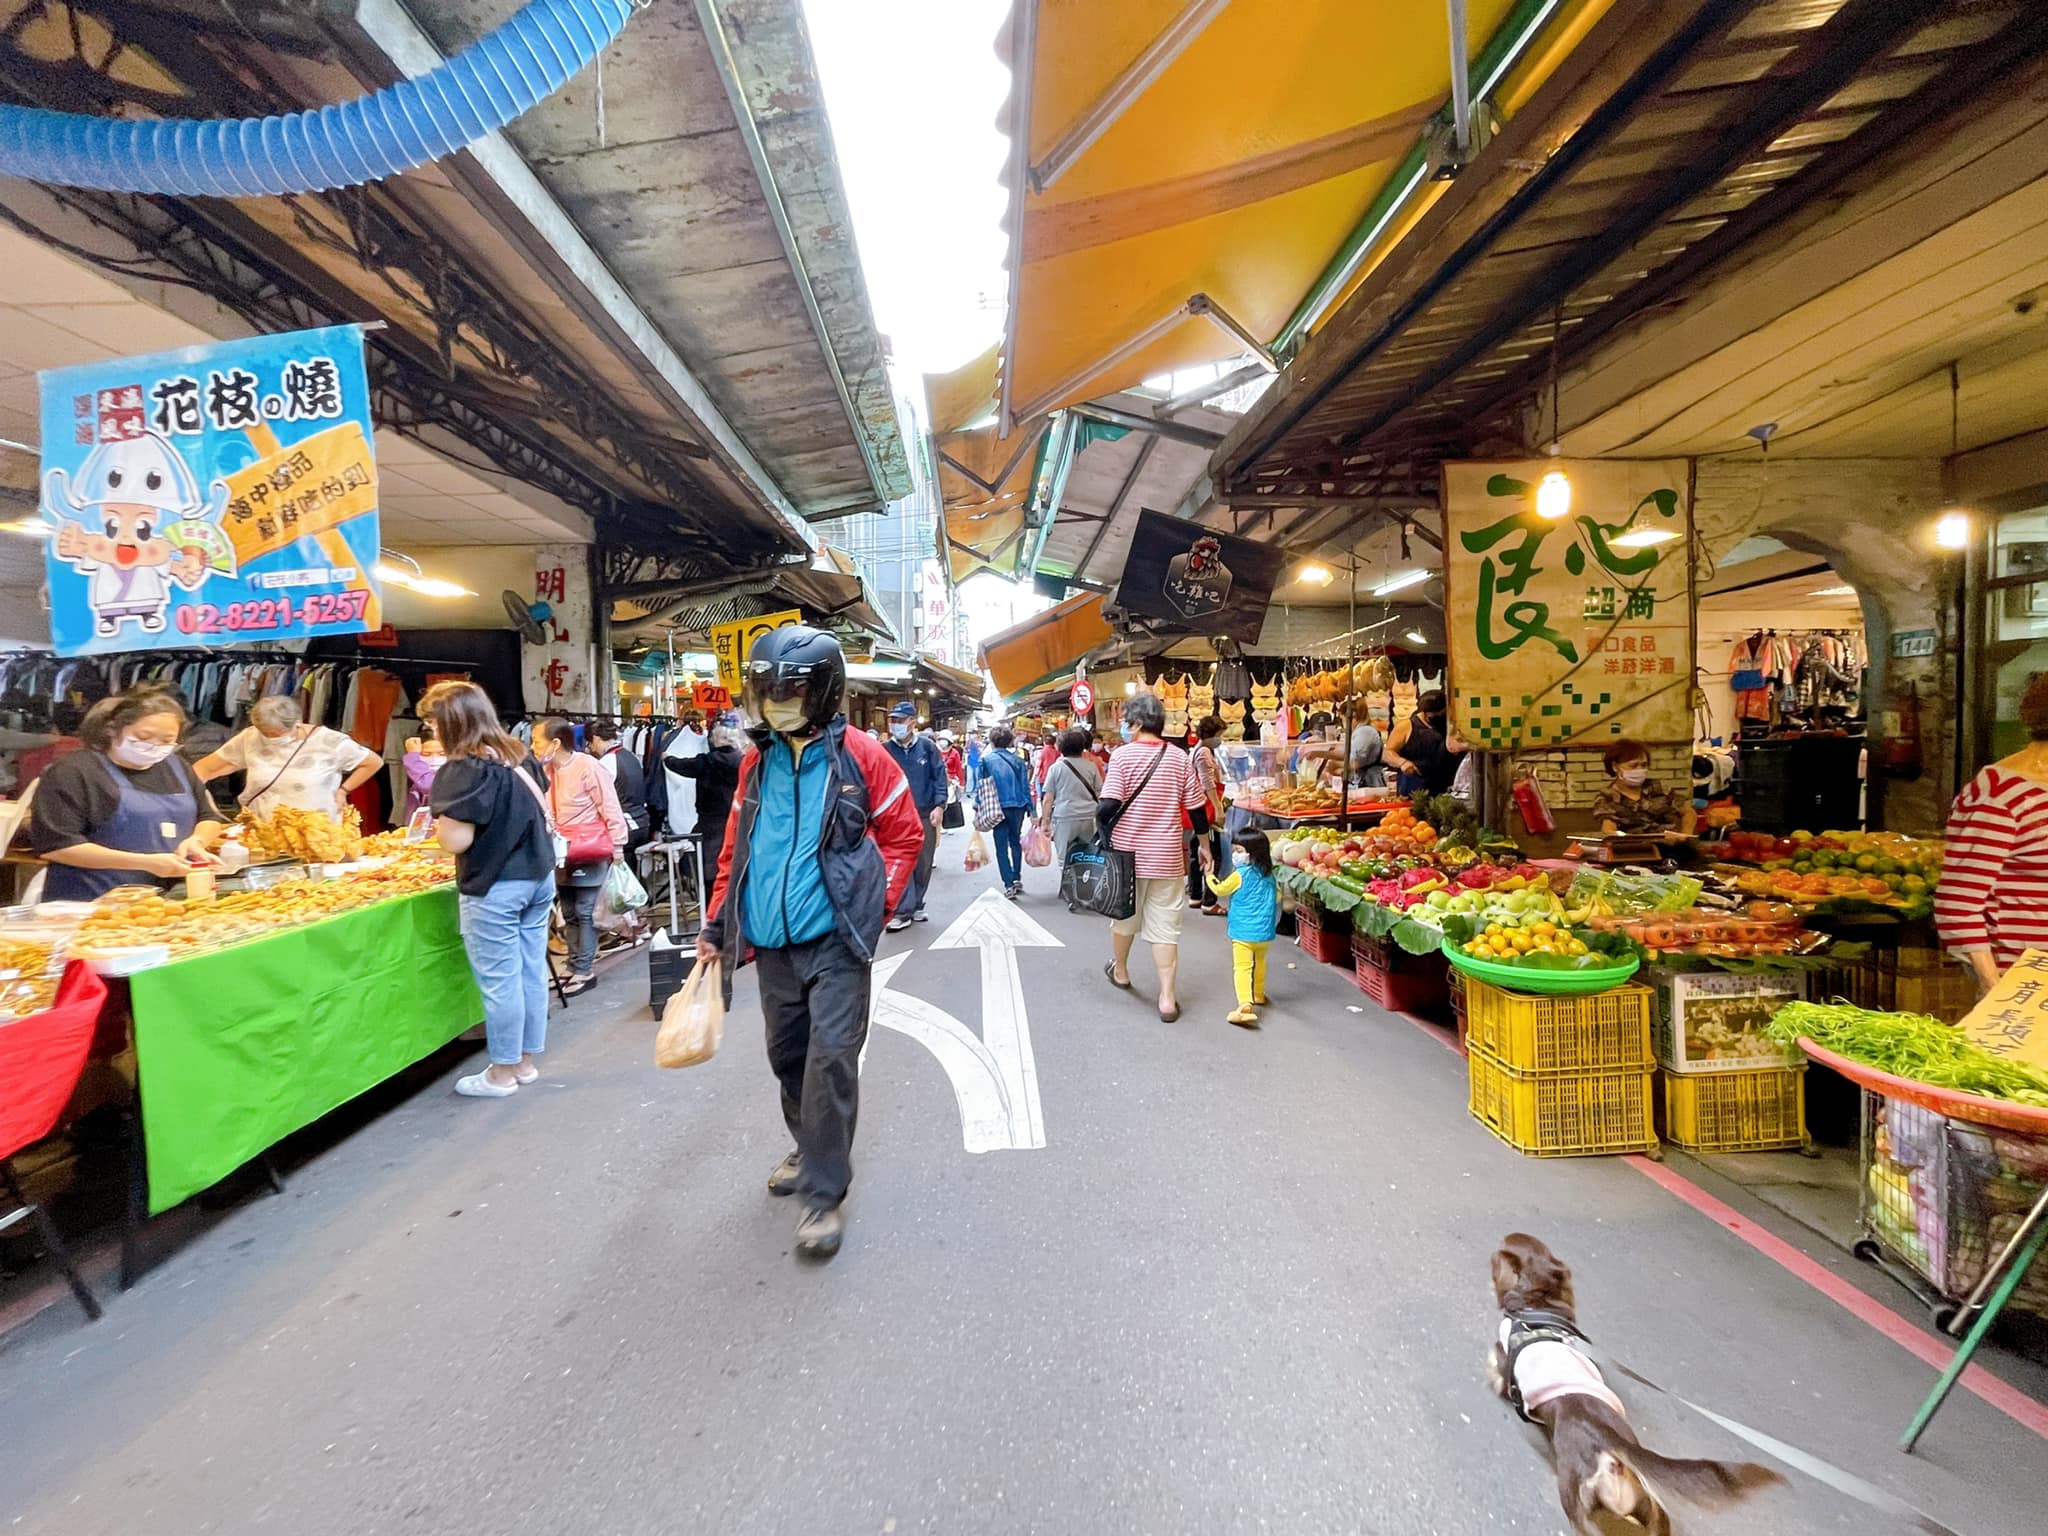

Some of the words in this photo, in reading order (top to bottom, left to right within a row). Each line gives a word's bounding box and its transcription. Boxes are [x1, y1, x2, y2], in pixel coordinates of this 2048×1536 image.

[153, 361, 338, 432] 花枝の燒
[176, 591, 369, 634] 02-8221-5257
[1583, 587, 1656, 620] 超商
[716, 633, 734, 679] 每件
[696, 687, 727, 703] 120
